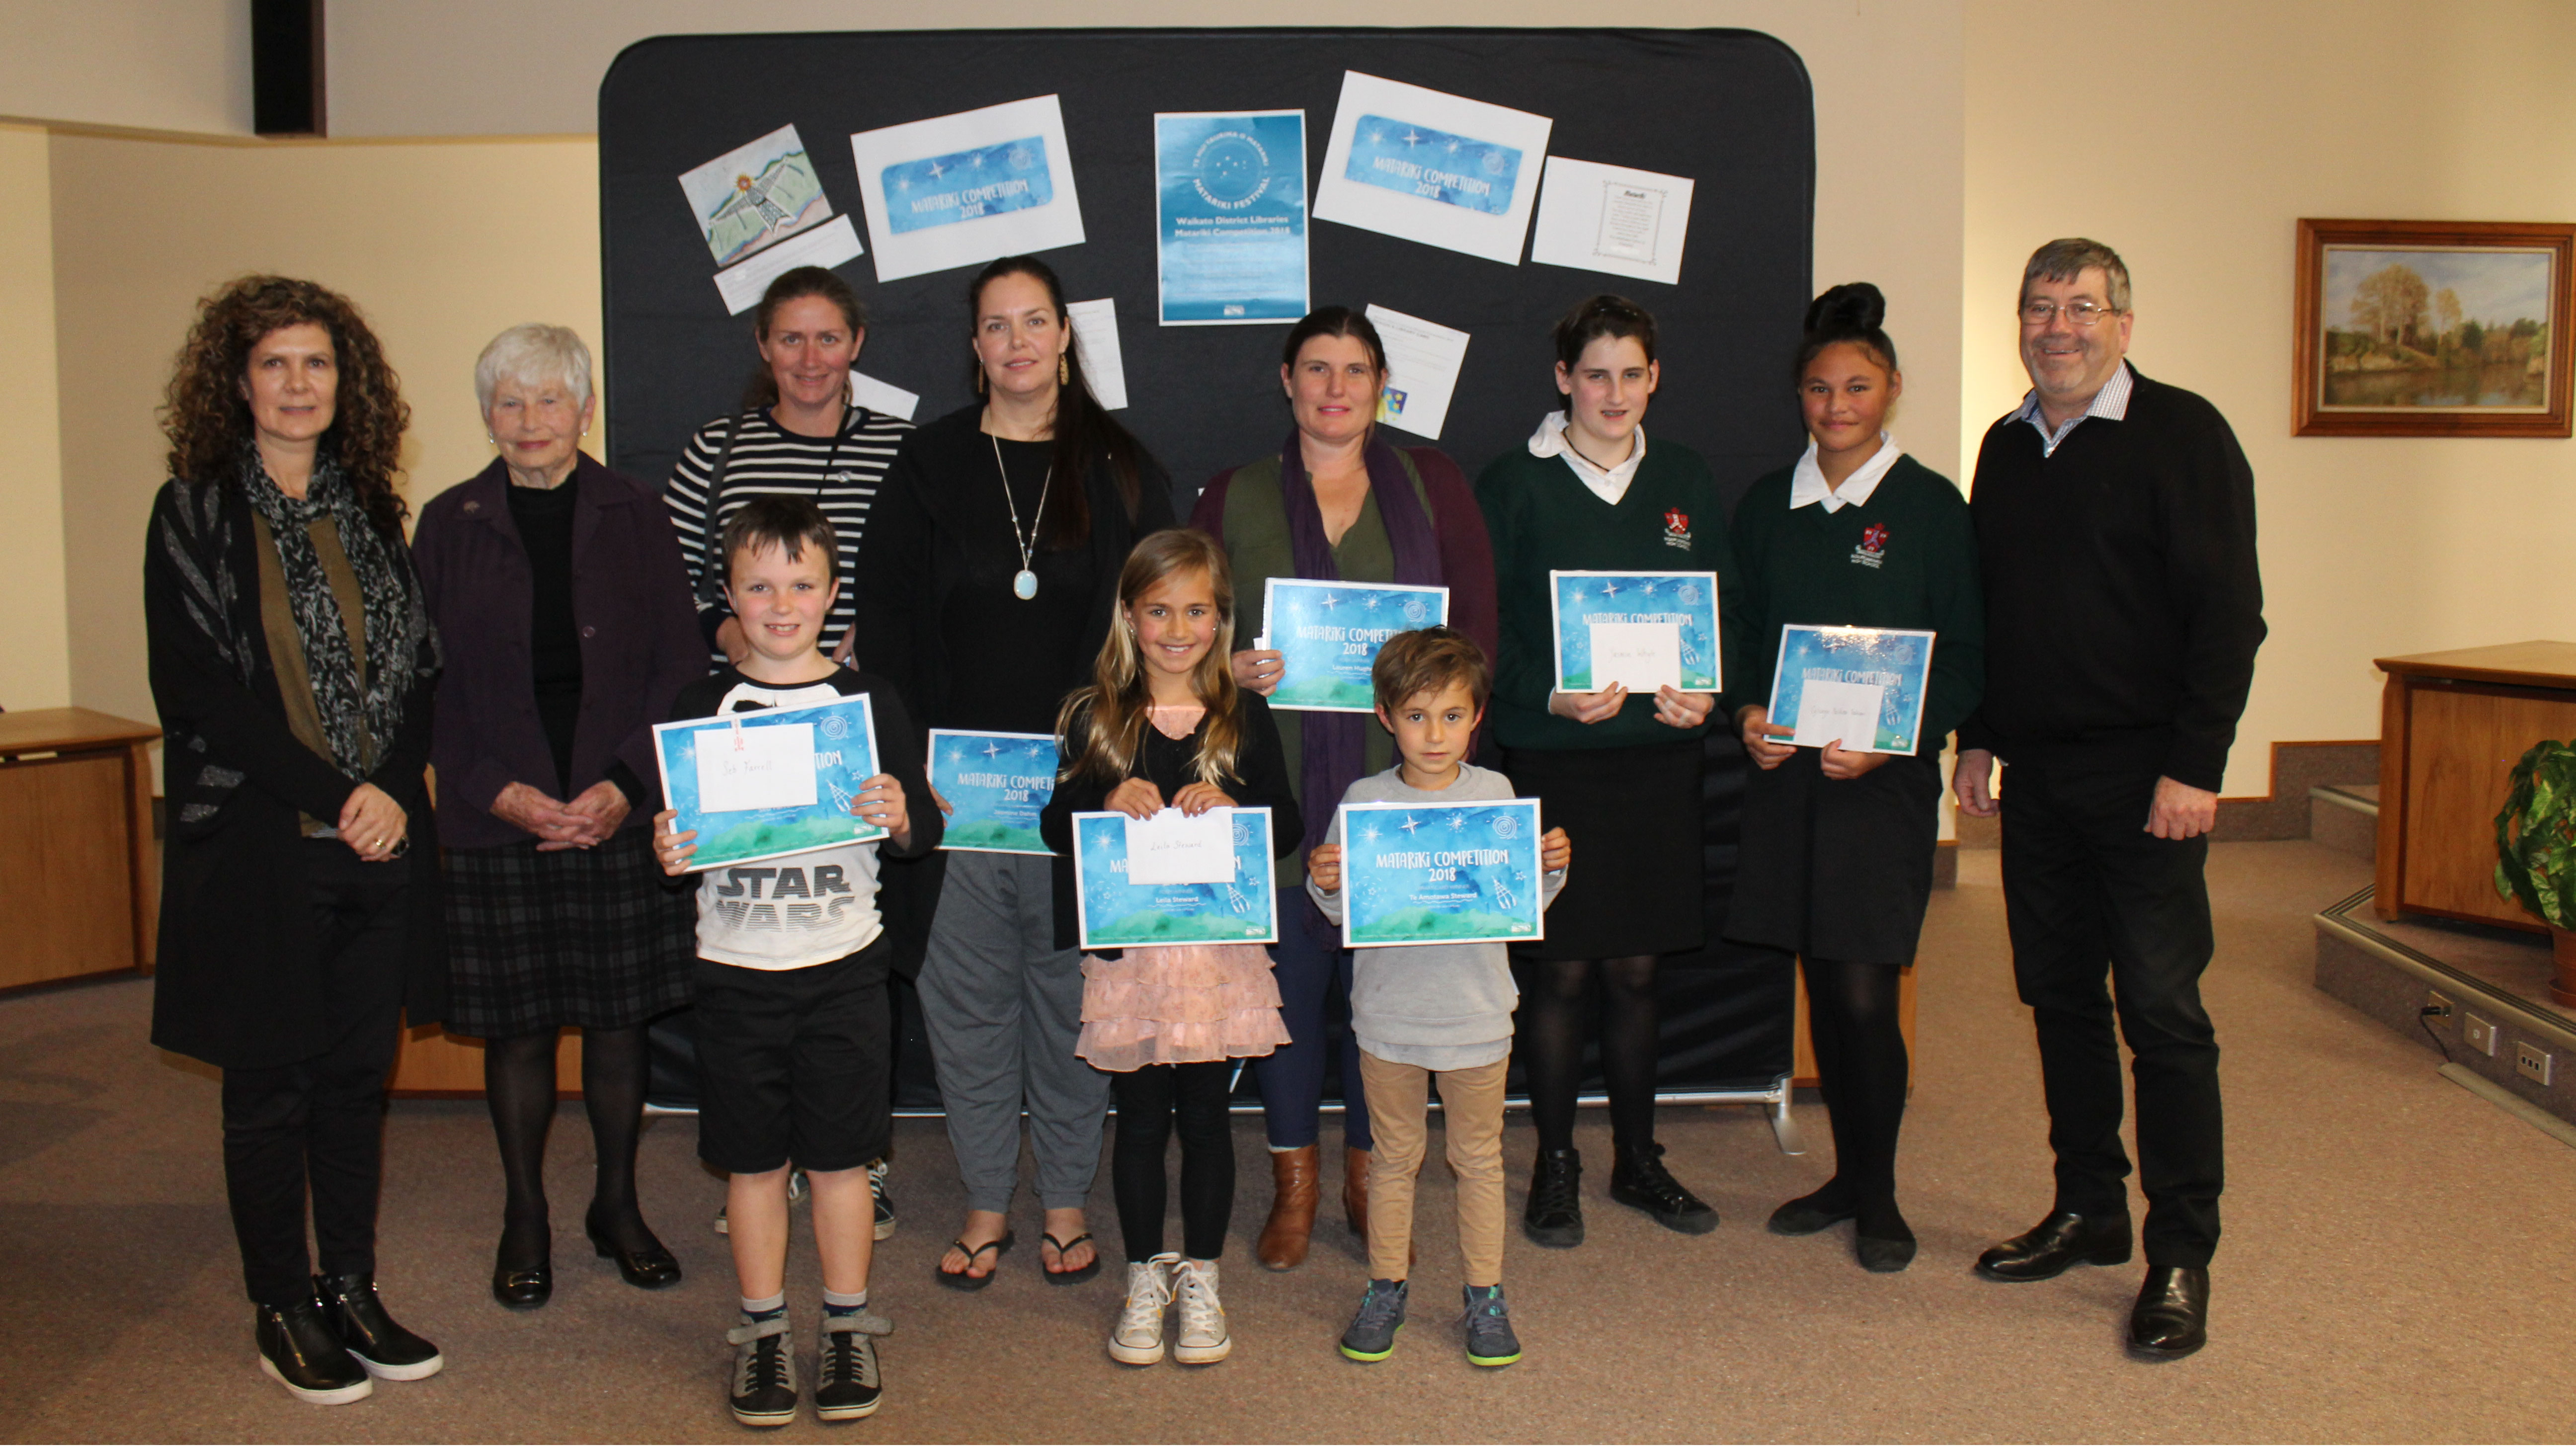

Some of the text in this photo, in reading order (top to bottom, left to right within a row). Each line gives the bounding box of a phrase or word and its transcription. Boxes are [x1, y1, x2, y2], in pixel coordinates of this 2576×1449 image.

[1192, 177, 1271, 210] MATARIKI FESTIVAL
[1416, 181, 1442, 199] 2018
[960, 201, 985, 219] 2018
[1176, 215, 1290, 226] Waikato District Libraries
[1343, 642, 1368, 656] 2018
[1003, 789, 1030, 803] 2018
[716, 865, 853, 900] STAR
[1428, 867, 1457, 882] 2018
[716, 895, 856, 932] WARS
